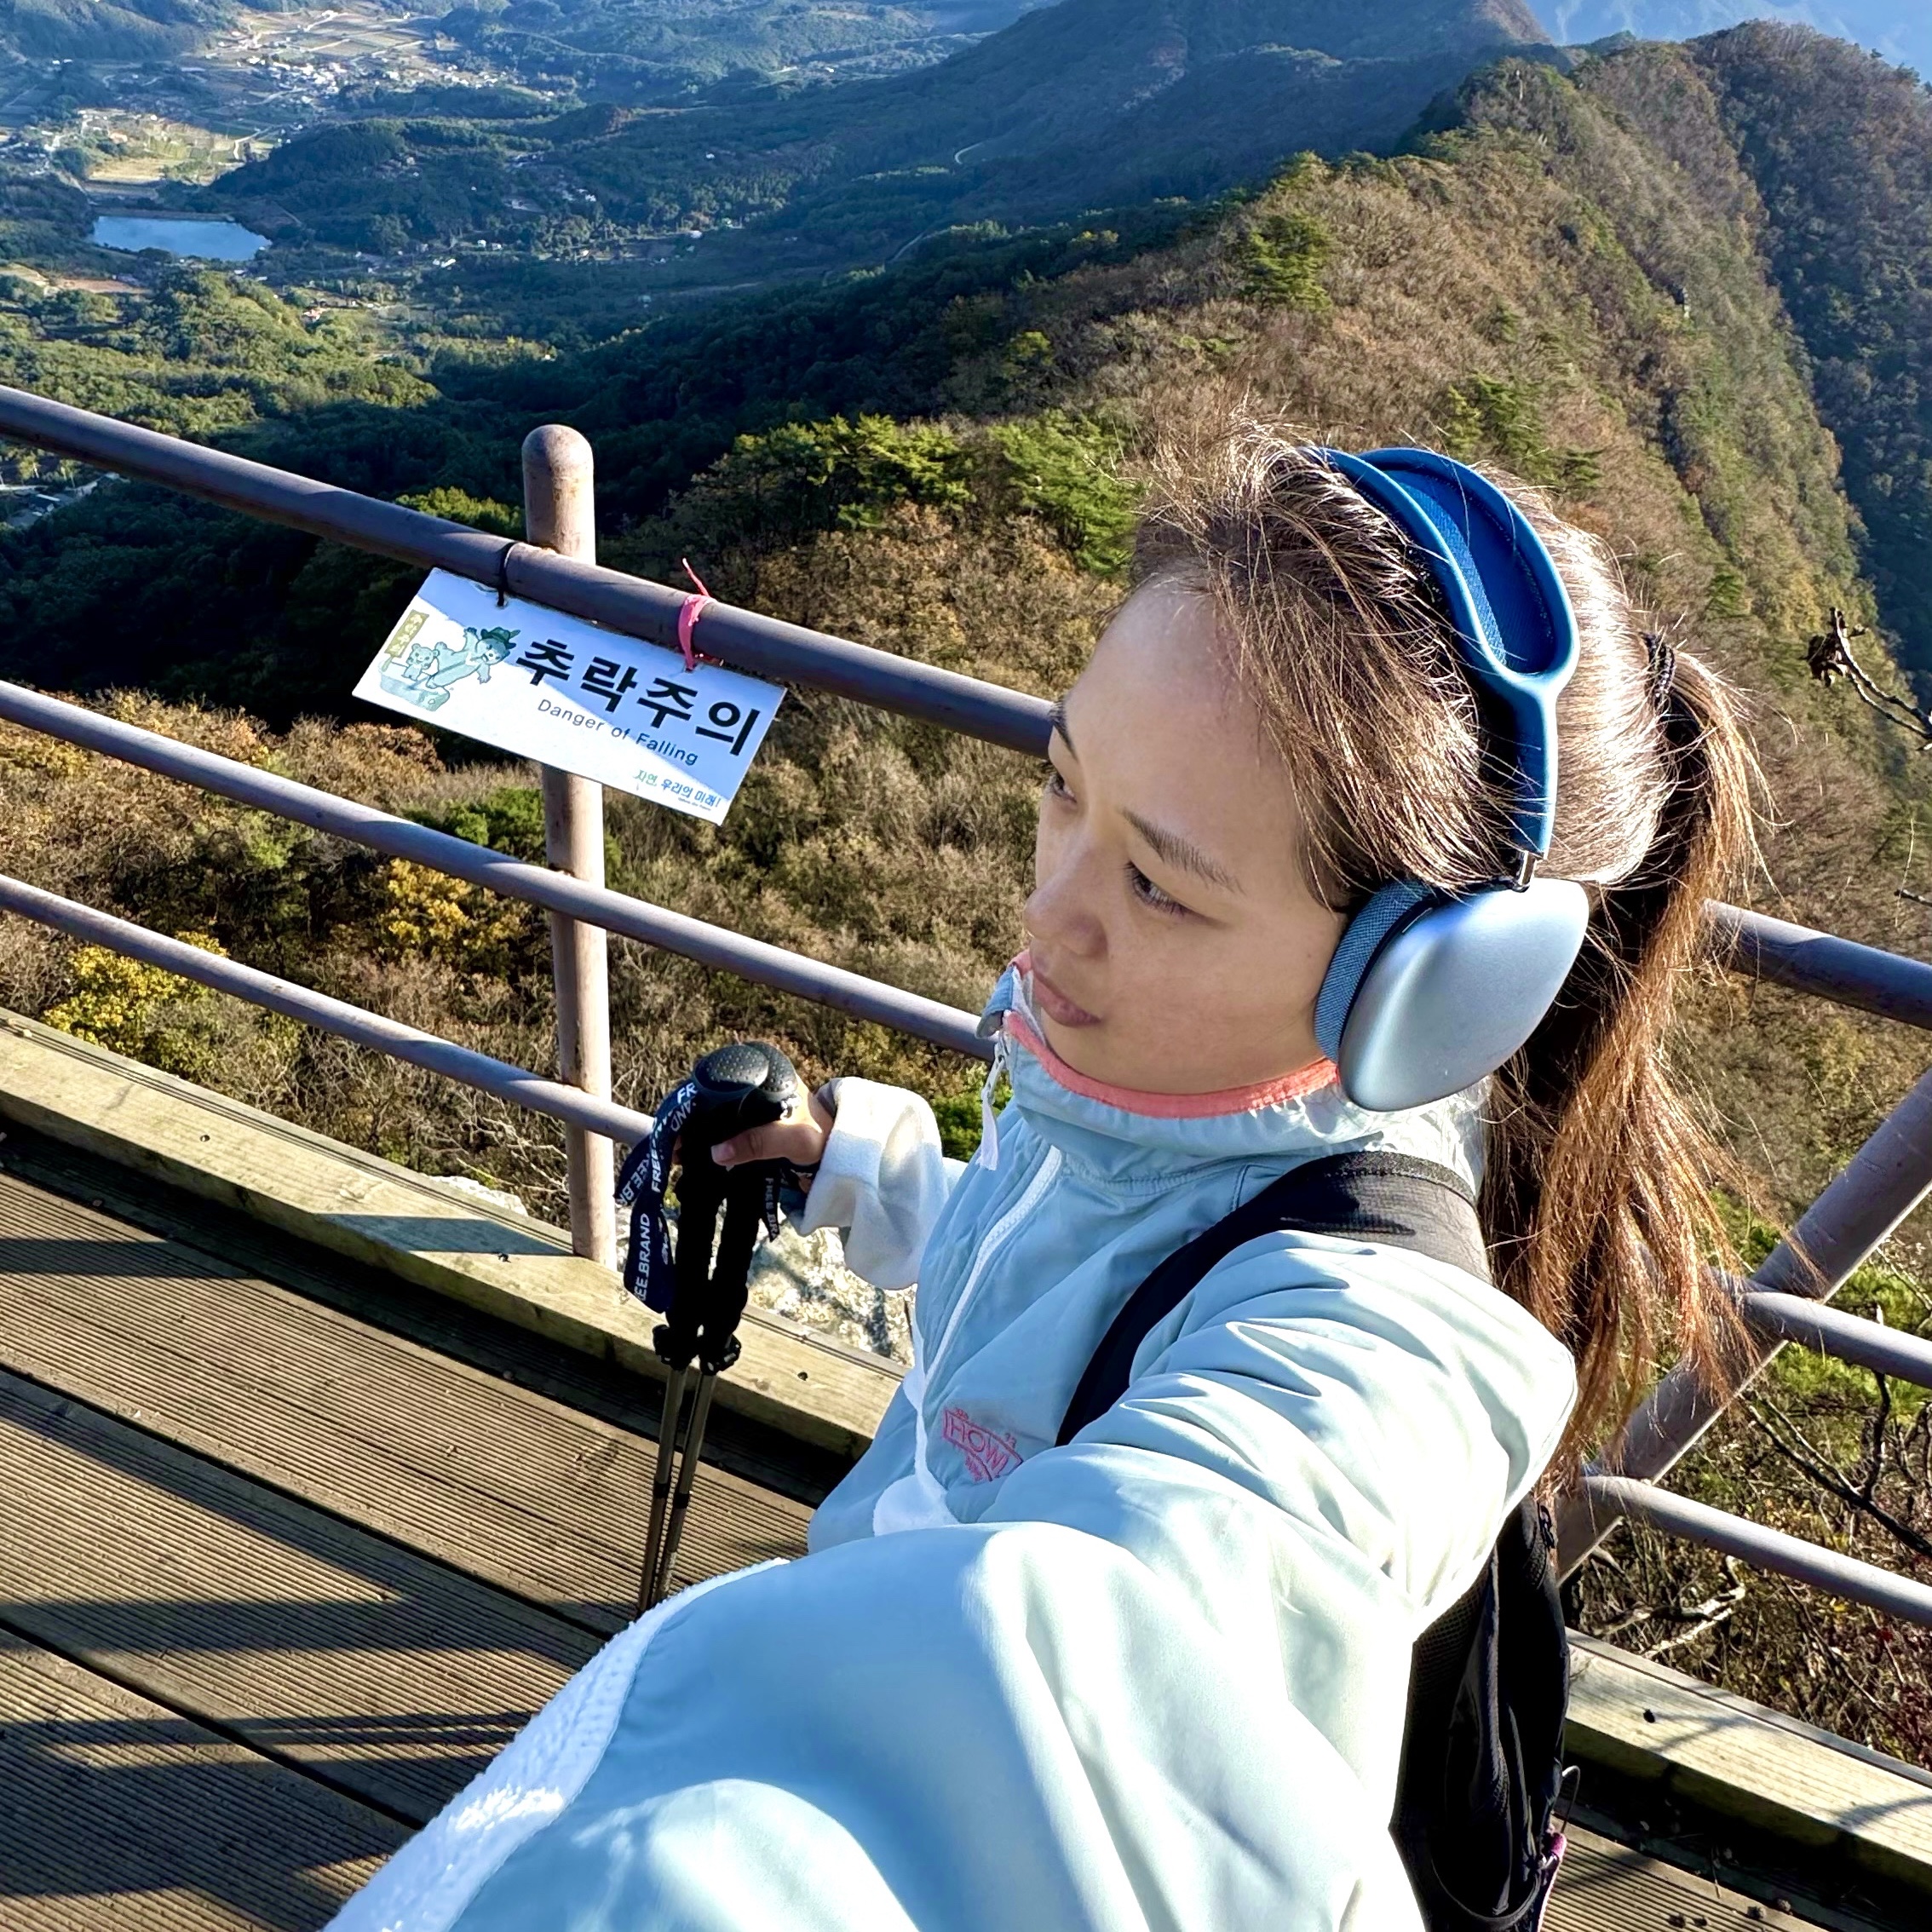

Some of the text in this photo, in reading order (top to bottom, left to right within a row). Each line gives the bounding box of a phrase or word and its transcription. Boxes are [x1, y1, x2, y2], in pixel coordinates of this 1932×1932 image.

[515, 639, 761, 756] 추락주의
[537, 699, 699, 767] Danger of Falling
[661, 779, 694, 799] 우리의
[638, 1213, 651, 1278] BRAND
